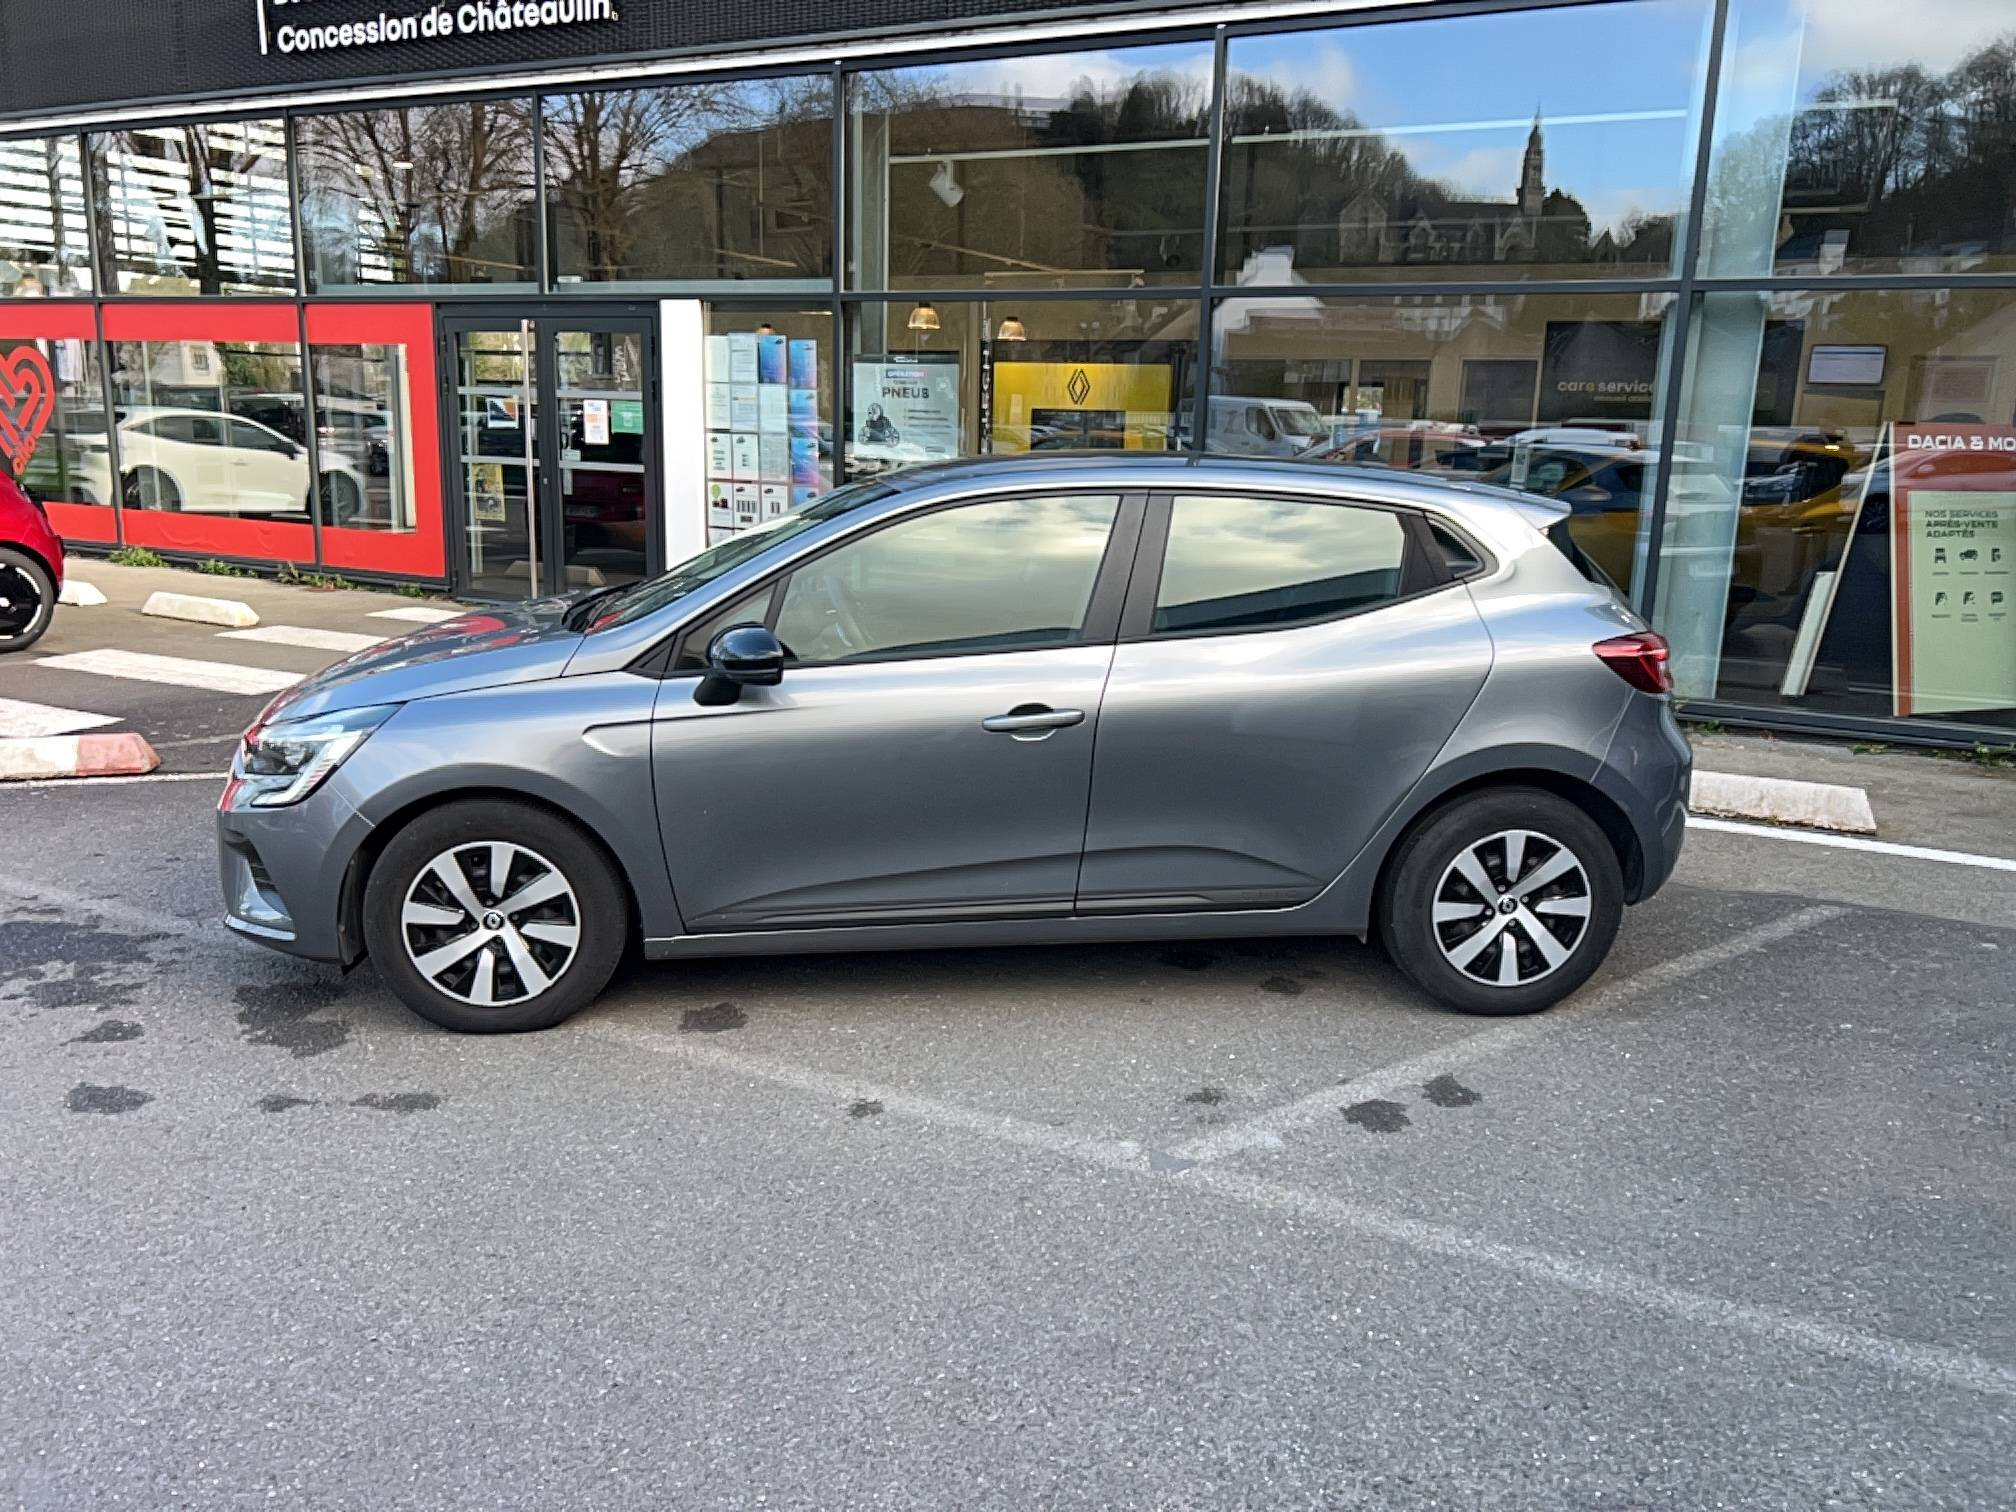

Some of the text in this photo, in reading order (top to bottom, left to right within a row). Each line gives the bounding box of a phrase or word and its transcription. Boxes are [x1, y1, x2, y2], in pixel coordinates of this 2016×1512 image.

[277, 13, 418, 53] Concession
[421, 6, 453, 37] de
[1557, 381, 1595, 392] care
[881, 387, 930, 399] PNEUS
[1908, 434, 1966, 449] DACIA
[1970, 436, 1984, 450] &
[1924, 510, 1999, 519] NOS SERVICES
